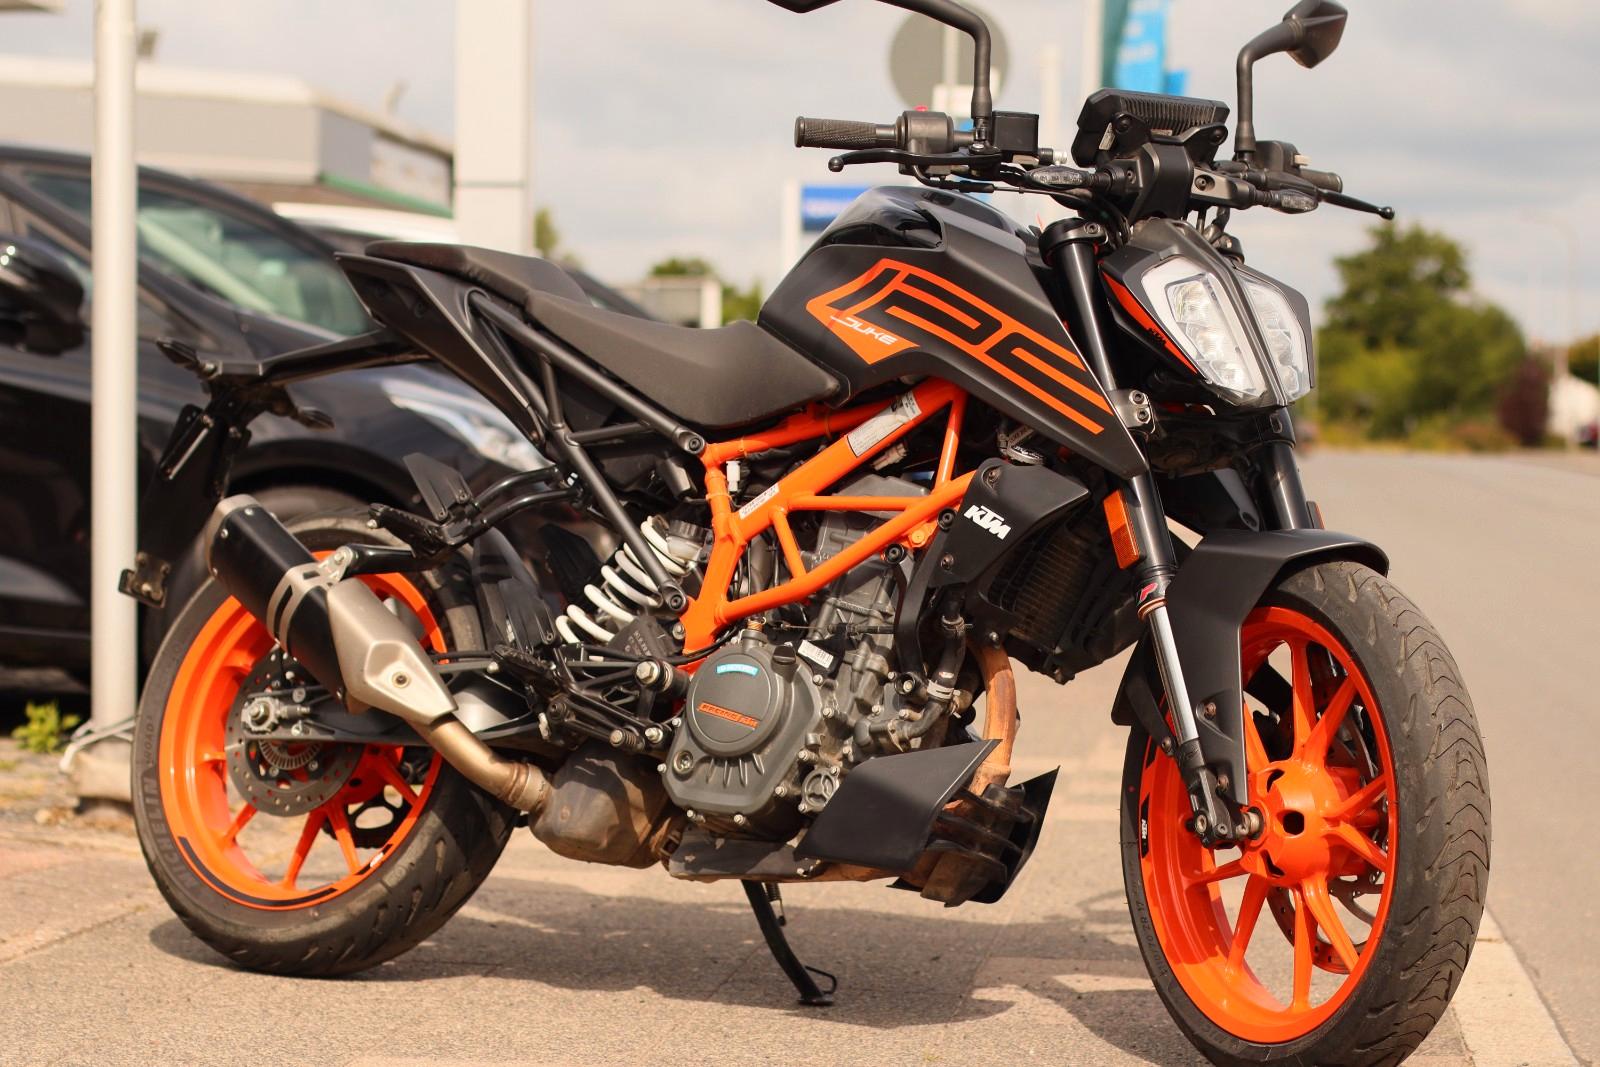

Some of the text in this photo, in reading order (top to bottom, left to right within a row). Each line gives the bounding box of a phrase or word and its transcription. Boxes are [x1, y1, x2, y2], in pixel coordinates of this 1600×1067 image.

[830, 315, 898, 346] DUKE
[963, 504, 1012, 540] KTM
[143, 775, 198, 893] MICHELIN
